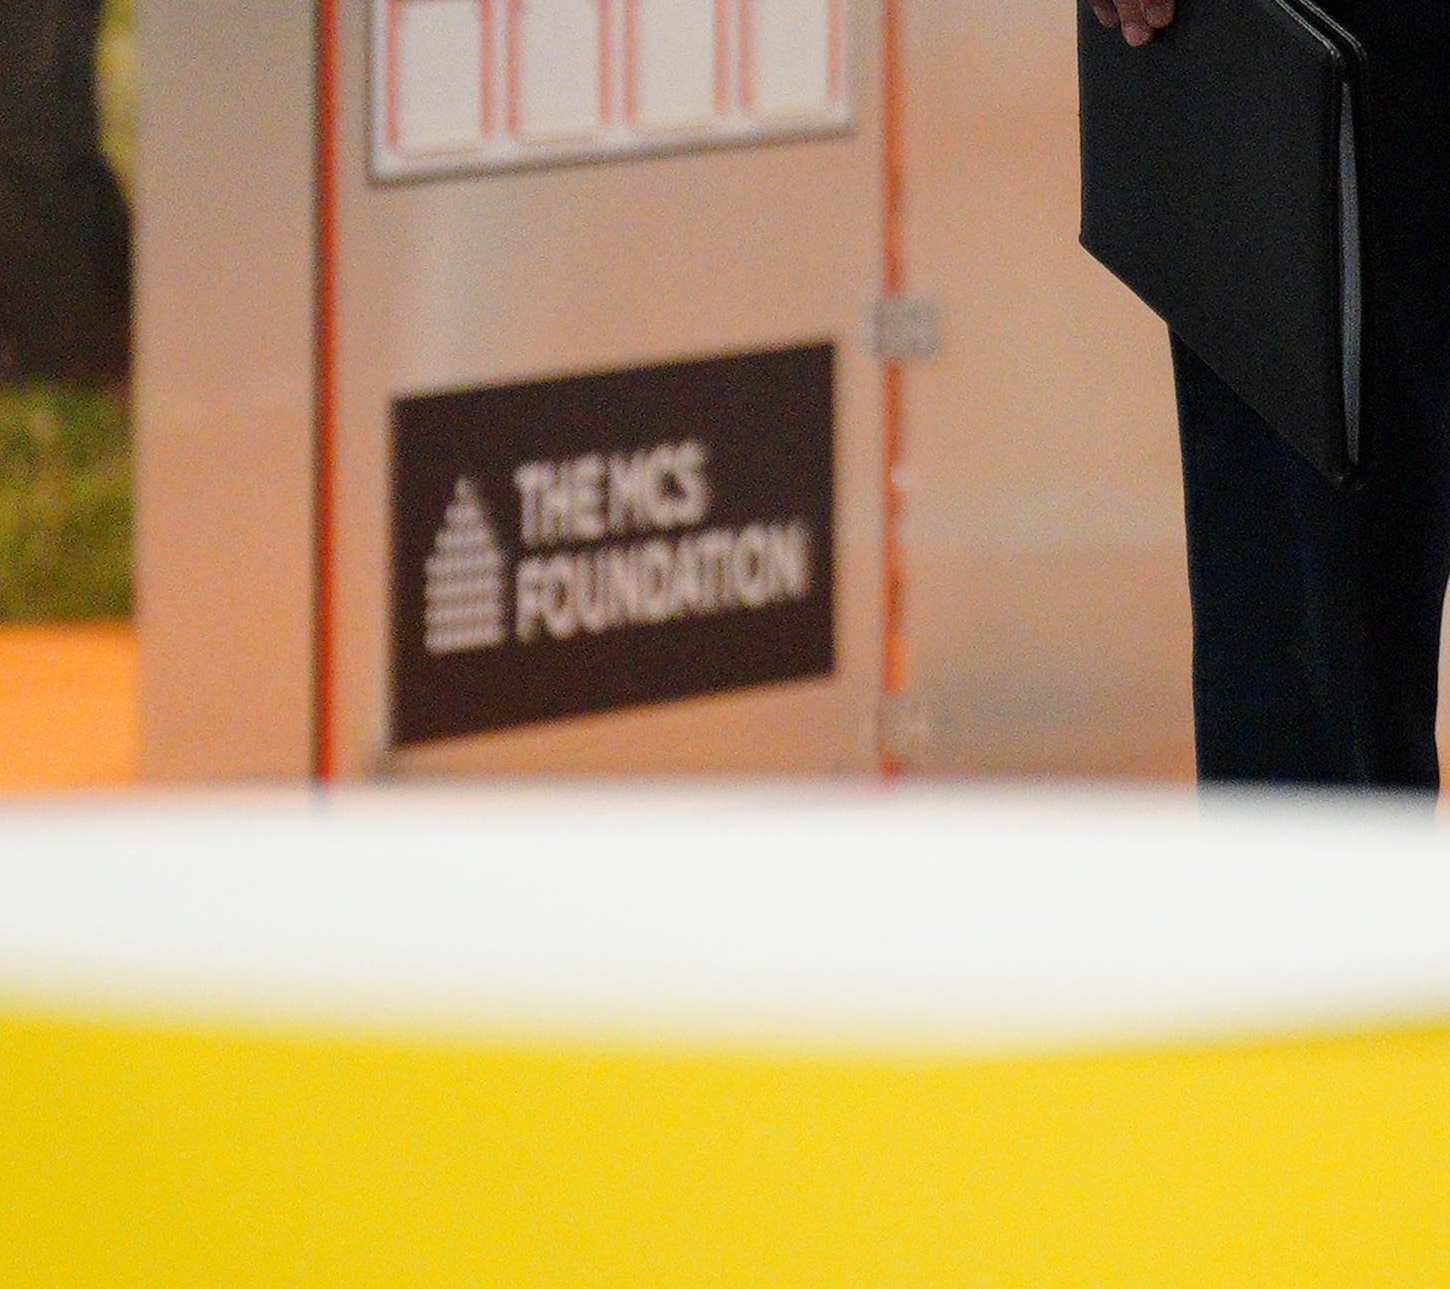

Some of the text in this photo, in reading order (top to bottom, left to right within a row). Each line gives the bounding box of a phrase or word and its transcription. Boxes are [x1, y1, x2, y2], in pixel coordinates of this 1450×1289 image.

[514, 439, 708, 550] THE MCS
[515, 521, 808, 643] FOUNDATION
